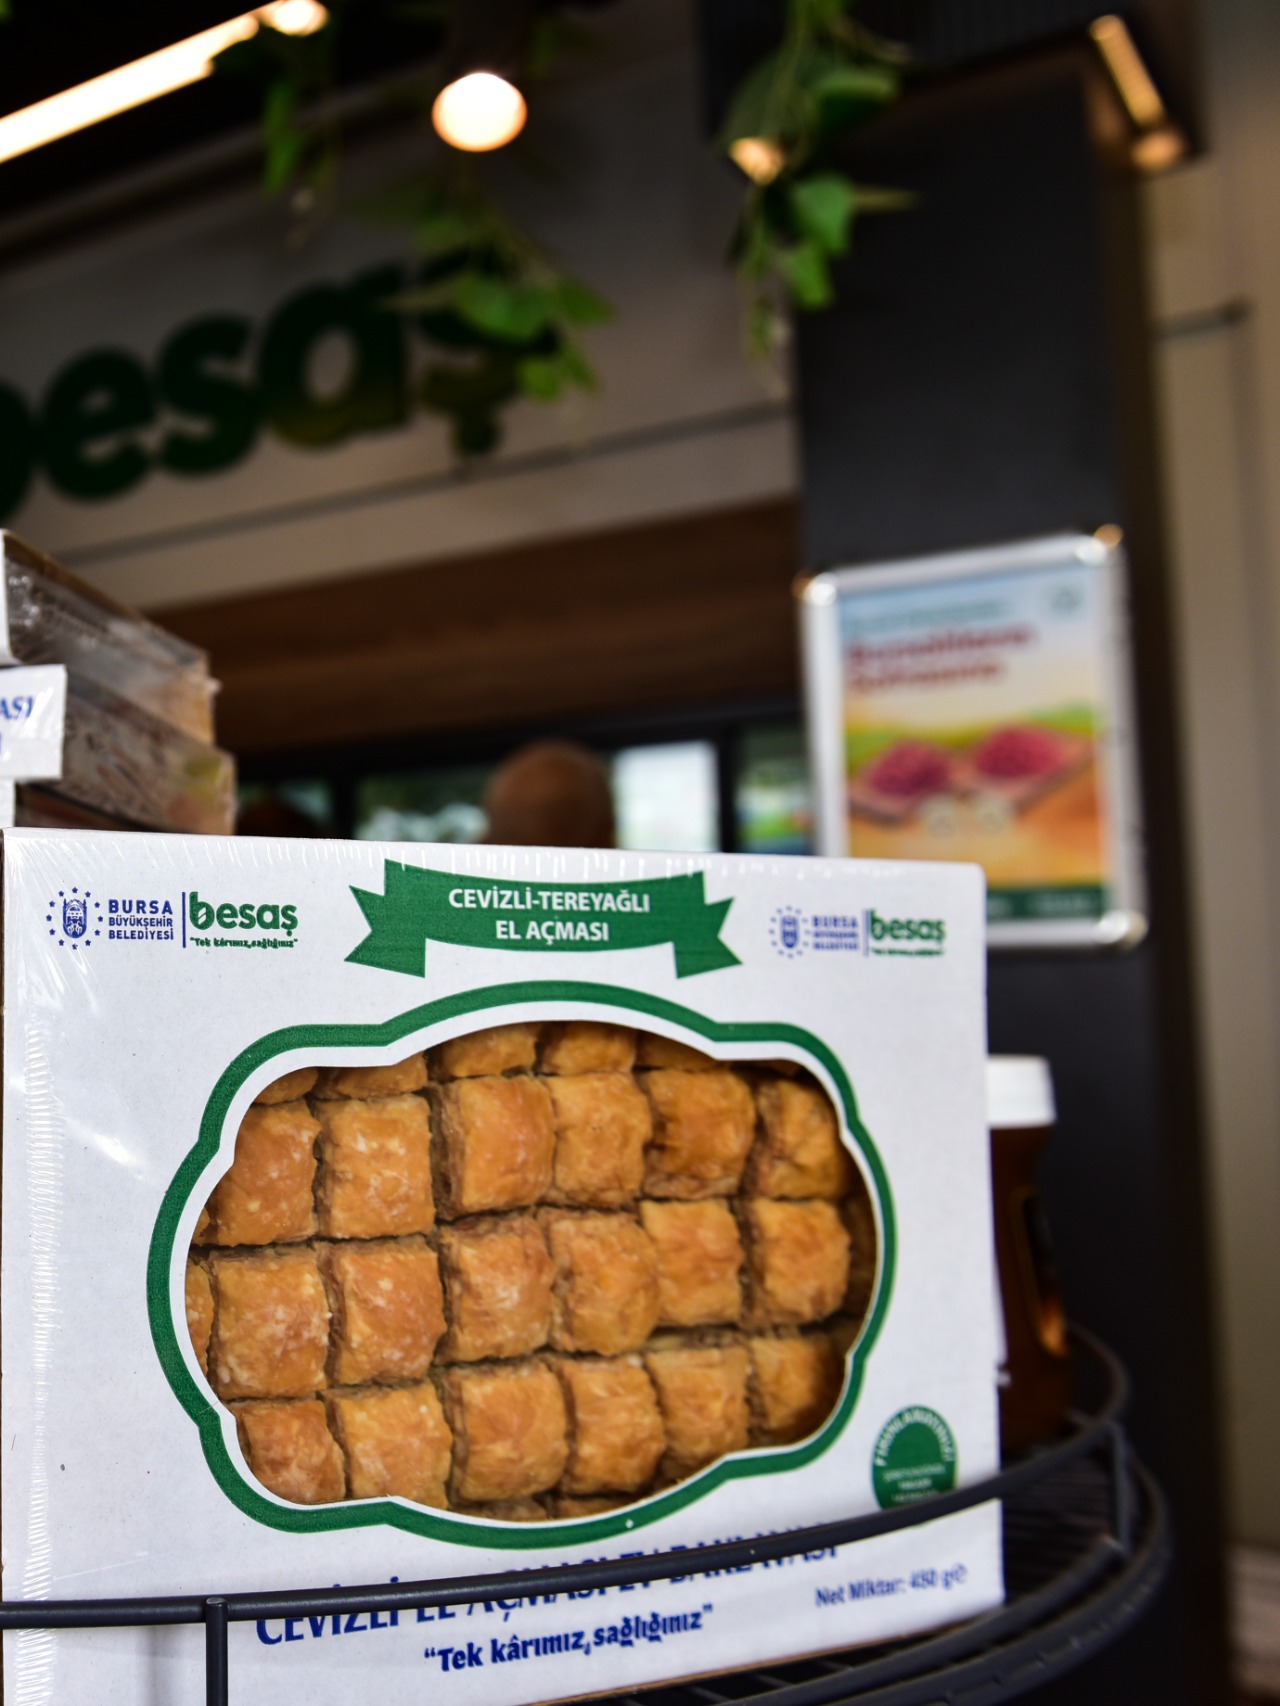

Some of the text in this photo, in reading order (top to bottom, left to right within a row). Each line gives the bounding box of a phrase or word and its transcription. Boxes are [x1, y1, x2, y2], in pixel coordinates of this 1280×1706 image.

[108, 899, 173, 914] BURSA
[448, 886, 650, 913] CEVİZLİ-TEREYAĞLI
[108, 914, 173, 928] BÜYÜKŞEHİR
[189, 891, 298, 937] besaş
[108, 928, 174, 940] BELEDİYESİ
[495, 920, 609, 945] EL AÇMASI
[870, 909, 946, 946] besaş
[815, 1585, 845, 1607] Net
